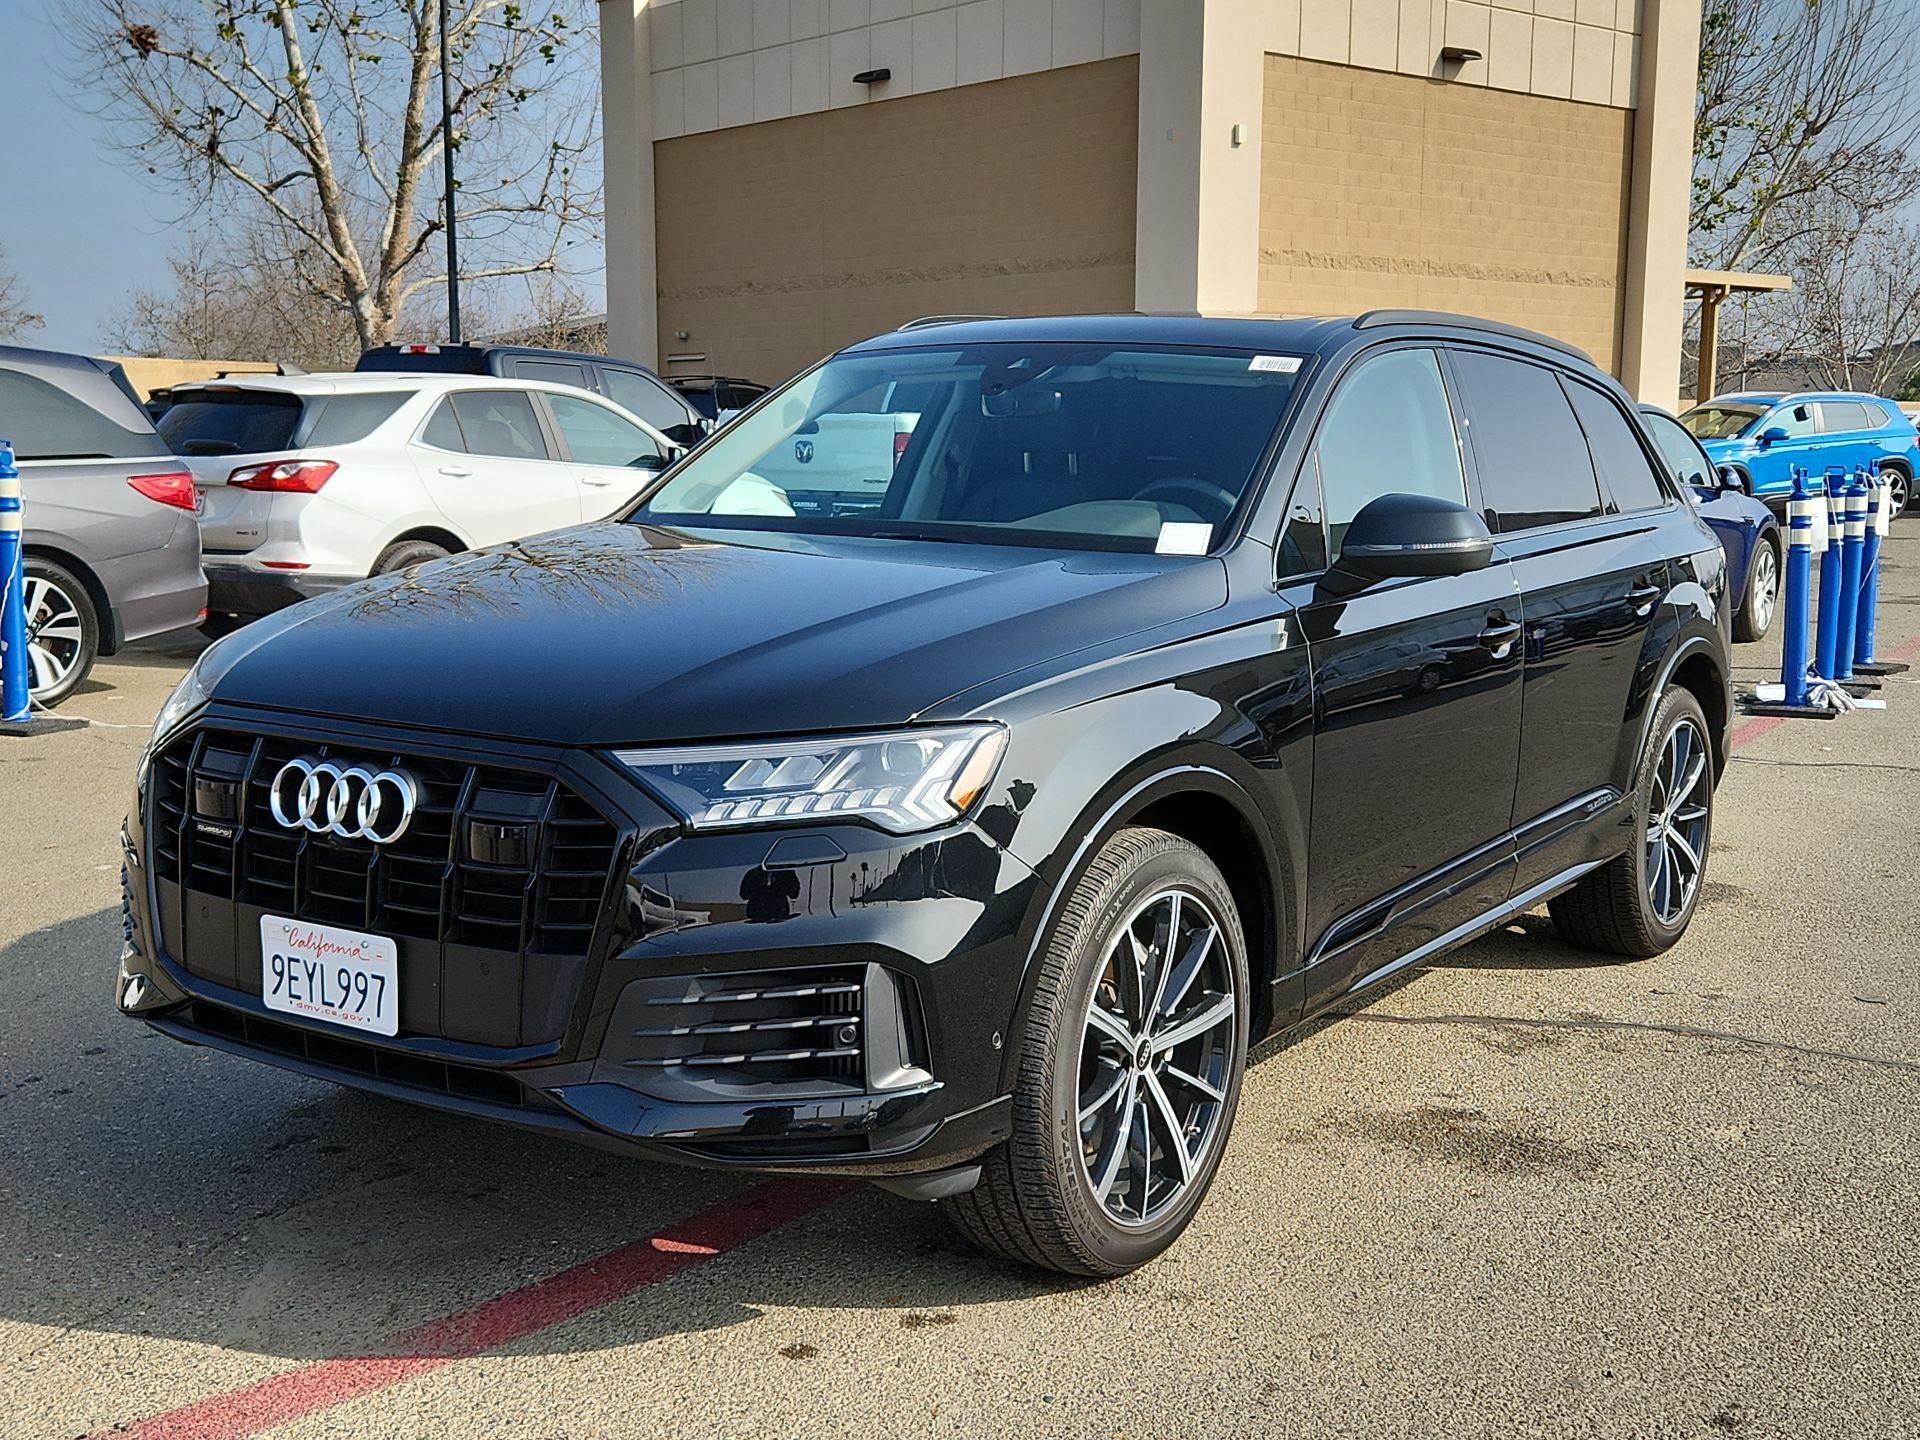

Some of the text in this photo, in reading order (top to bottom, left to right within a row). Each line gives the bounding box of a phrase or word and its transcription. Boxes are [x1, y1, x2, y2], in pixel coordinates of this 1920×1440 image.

[1109, 898, 1122, 918] LX
[288, 927, 370, 960] California
[271, 953, 386, 1018] 9EYL997
[296, 1001, 364, 1022] dmv.ca.gov
